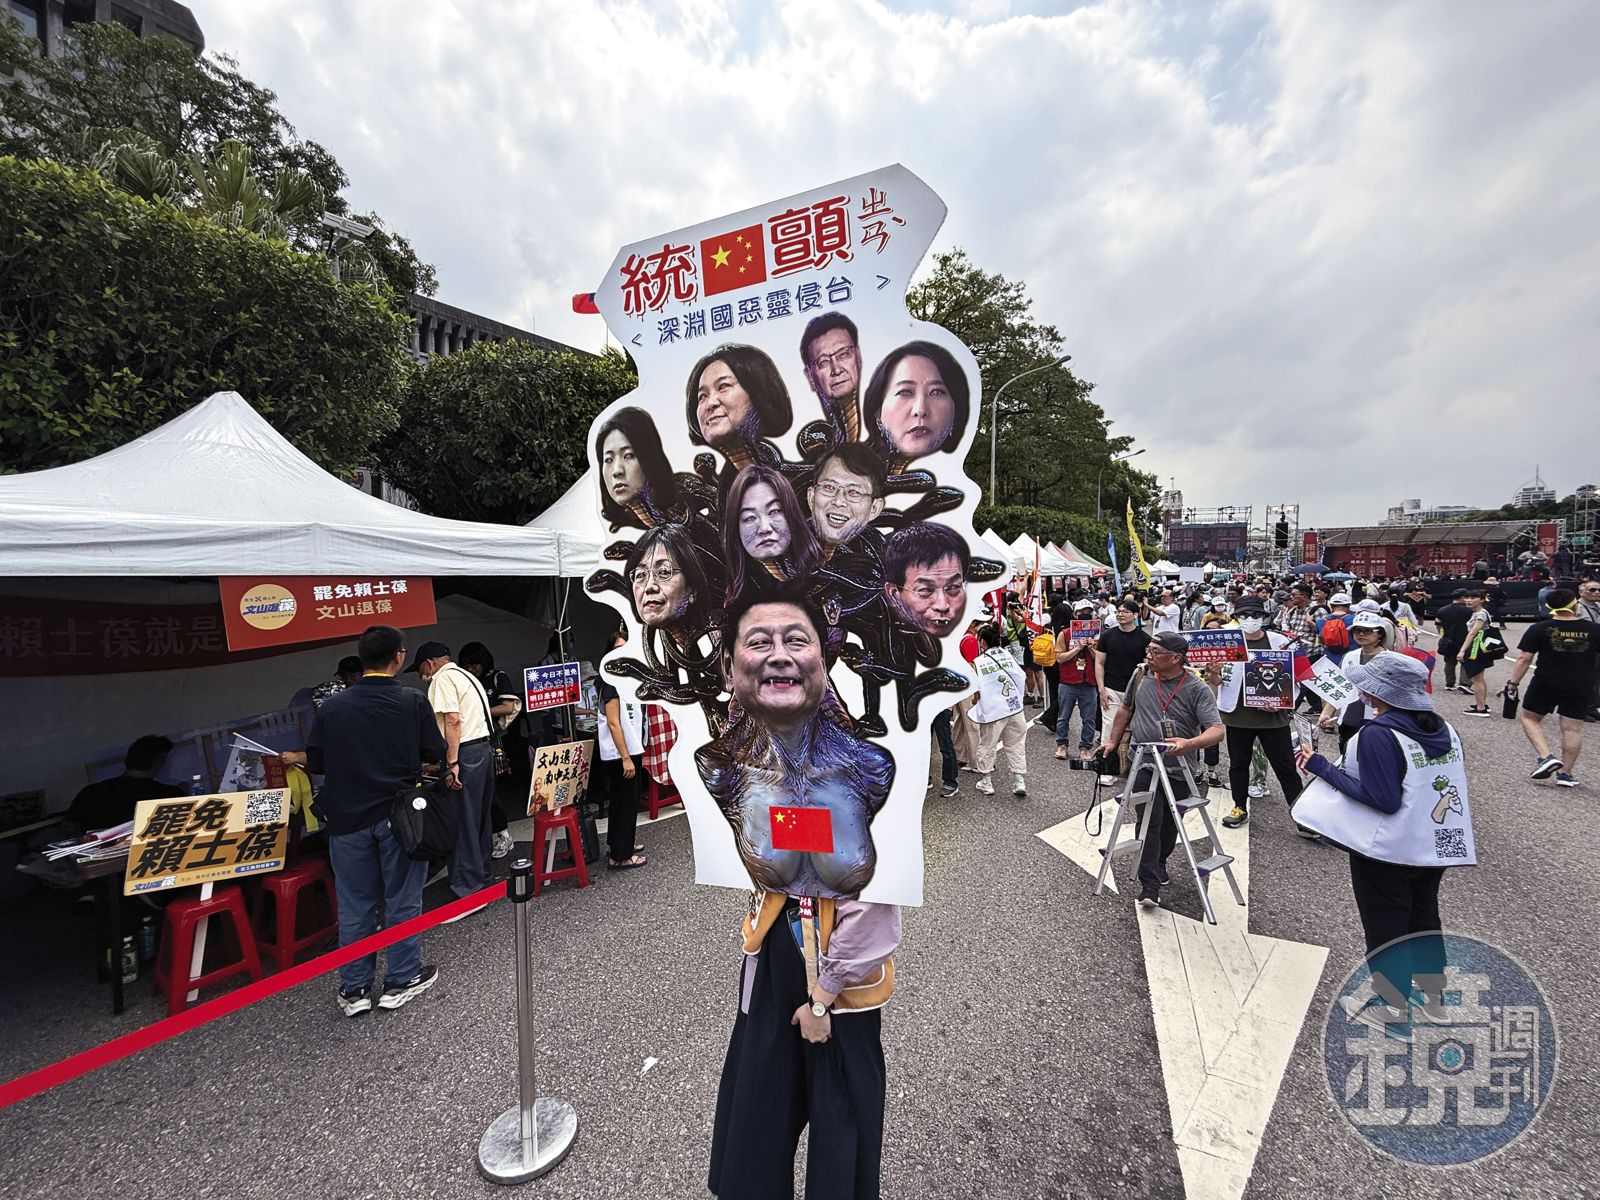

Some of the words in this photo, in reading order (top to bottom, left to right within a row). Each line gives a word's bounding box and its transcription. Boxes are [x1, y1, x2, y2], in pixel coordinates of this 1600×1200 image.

[657, 275, 853, 345] 深淵國惡靈侵台
[313, 580, 408, 601] 罷免賴士葆
[315, 599, 393, 620] 文山退葆
[1324, 668, 1354, 693] 大罷免
[138, 797, 233, 841] 罷免
[131, 822, 289, 878] 賴士葆
